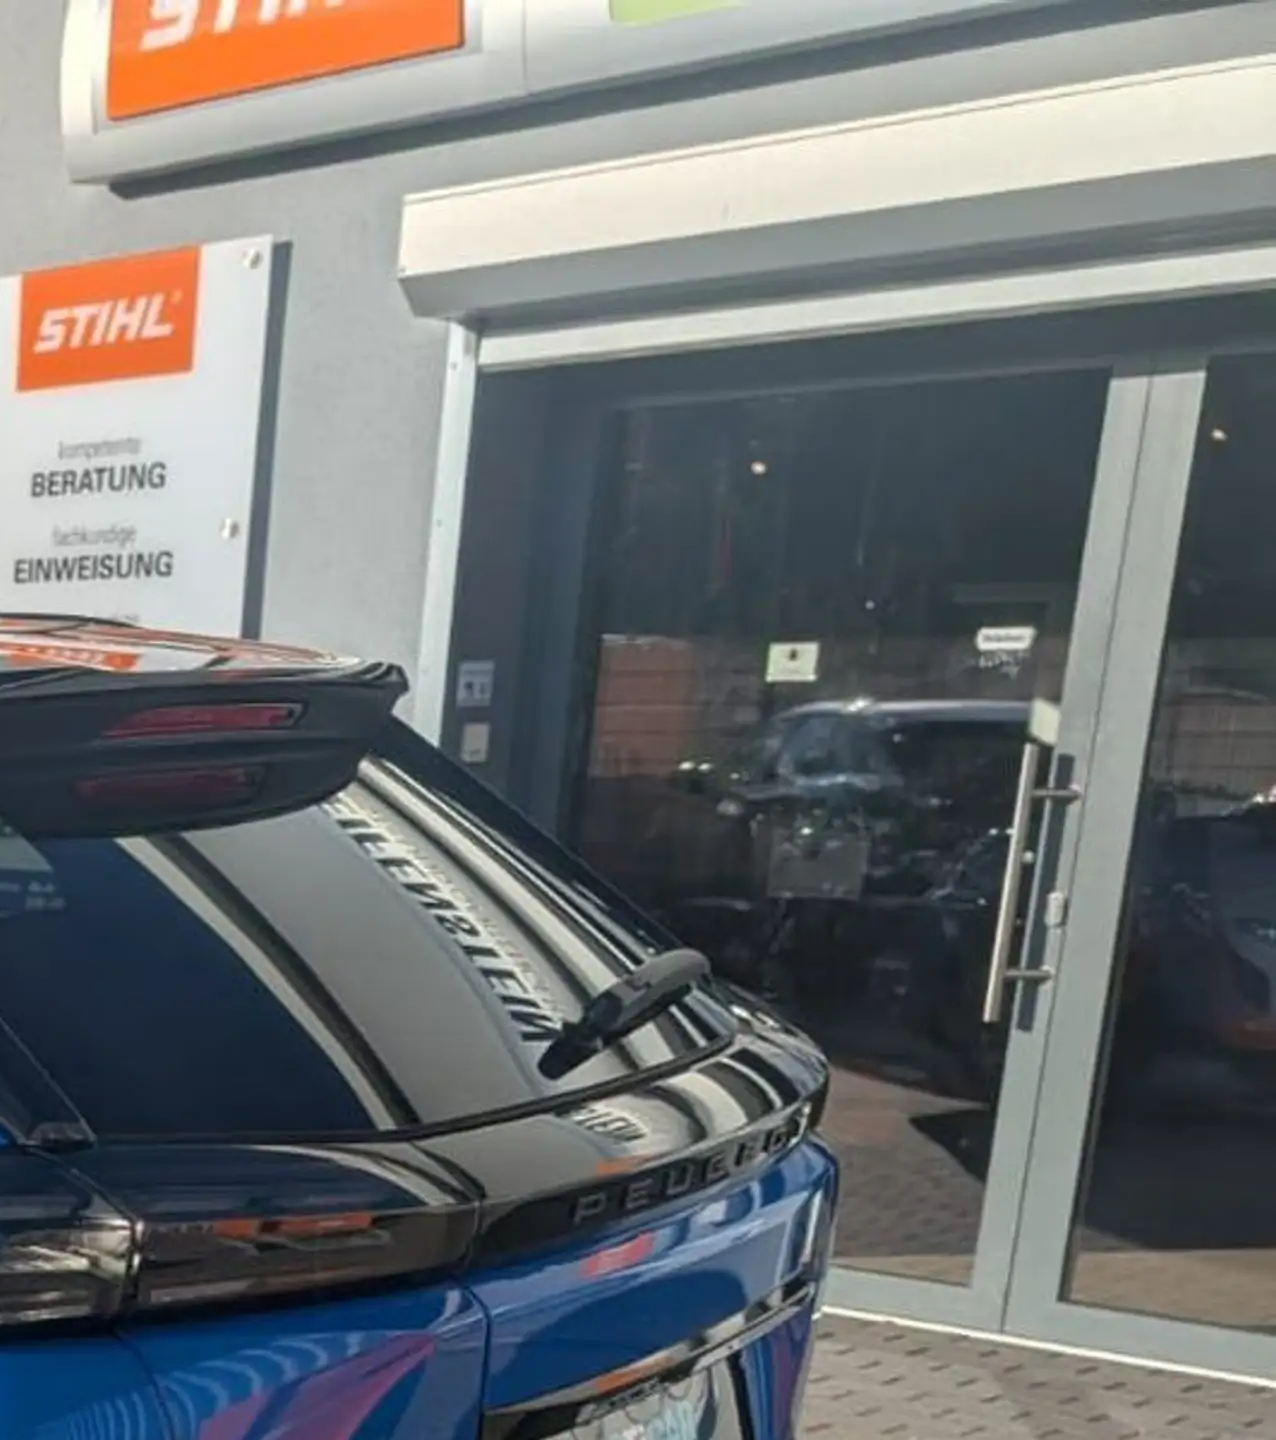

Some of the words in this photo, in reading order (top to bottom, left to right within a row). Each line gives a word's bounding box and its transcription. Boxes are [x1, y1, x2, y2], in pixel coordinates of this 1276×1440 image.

[33, 292, 174, 354] STIHL
[30, 461, 167, 498] BERATUNG
[13, 551, 174, 584] EINWEISUNG
